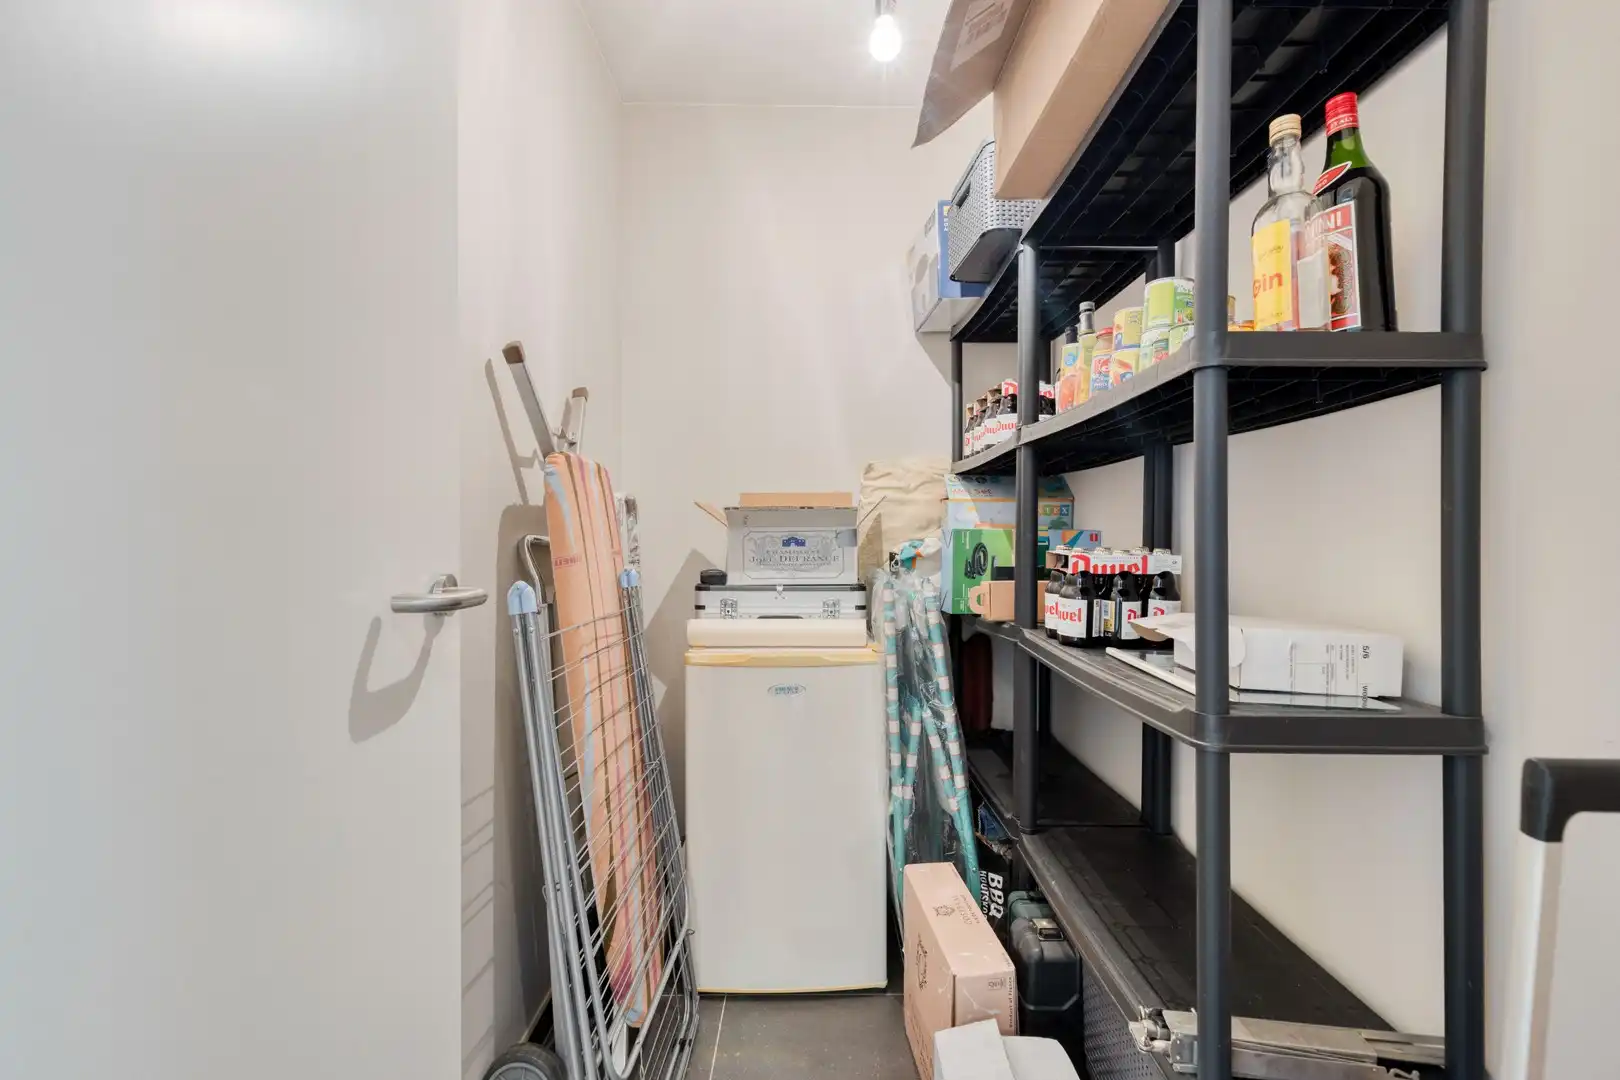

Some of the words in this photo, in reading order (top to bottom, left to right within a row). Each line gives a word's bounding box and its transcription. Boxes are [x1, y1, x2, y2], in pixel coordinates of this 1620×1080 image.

[1071, 554, 1148, 575] Duvel
[1361, 644, 1371, 660] 5/6
[988, 872, 1005, 919] BBQ
